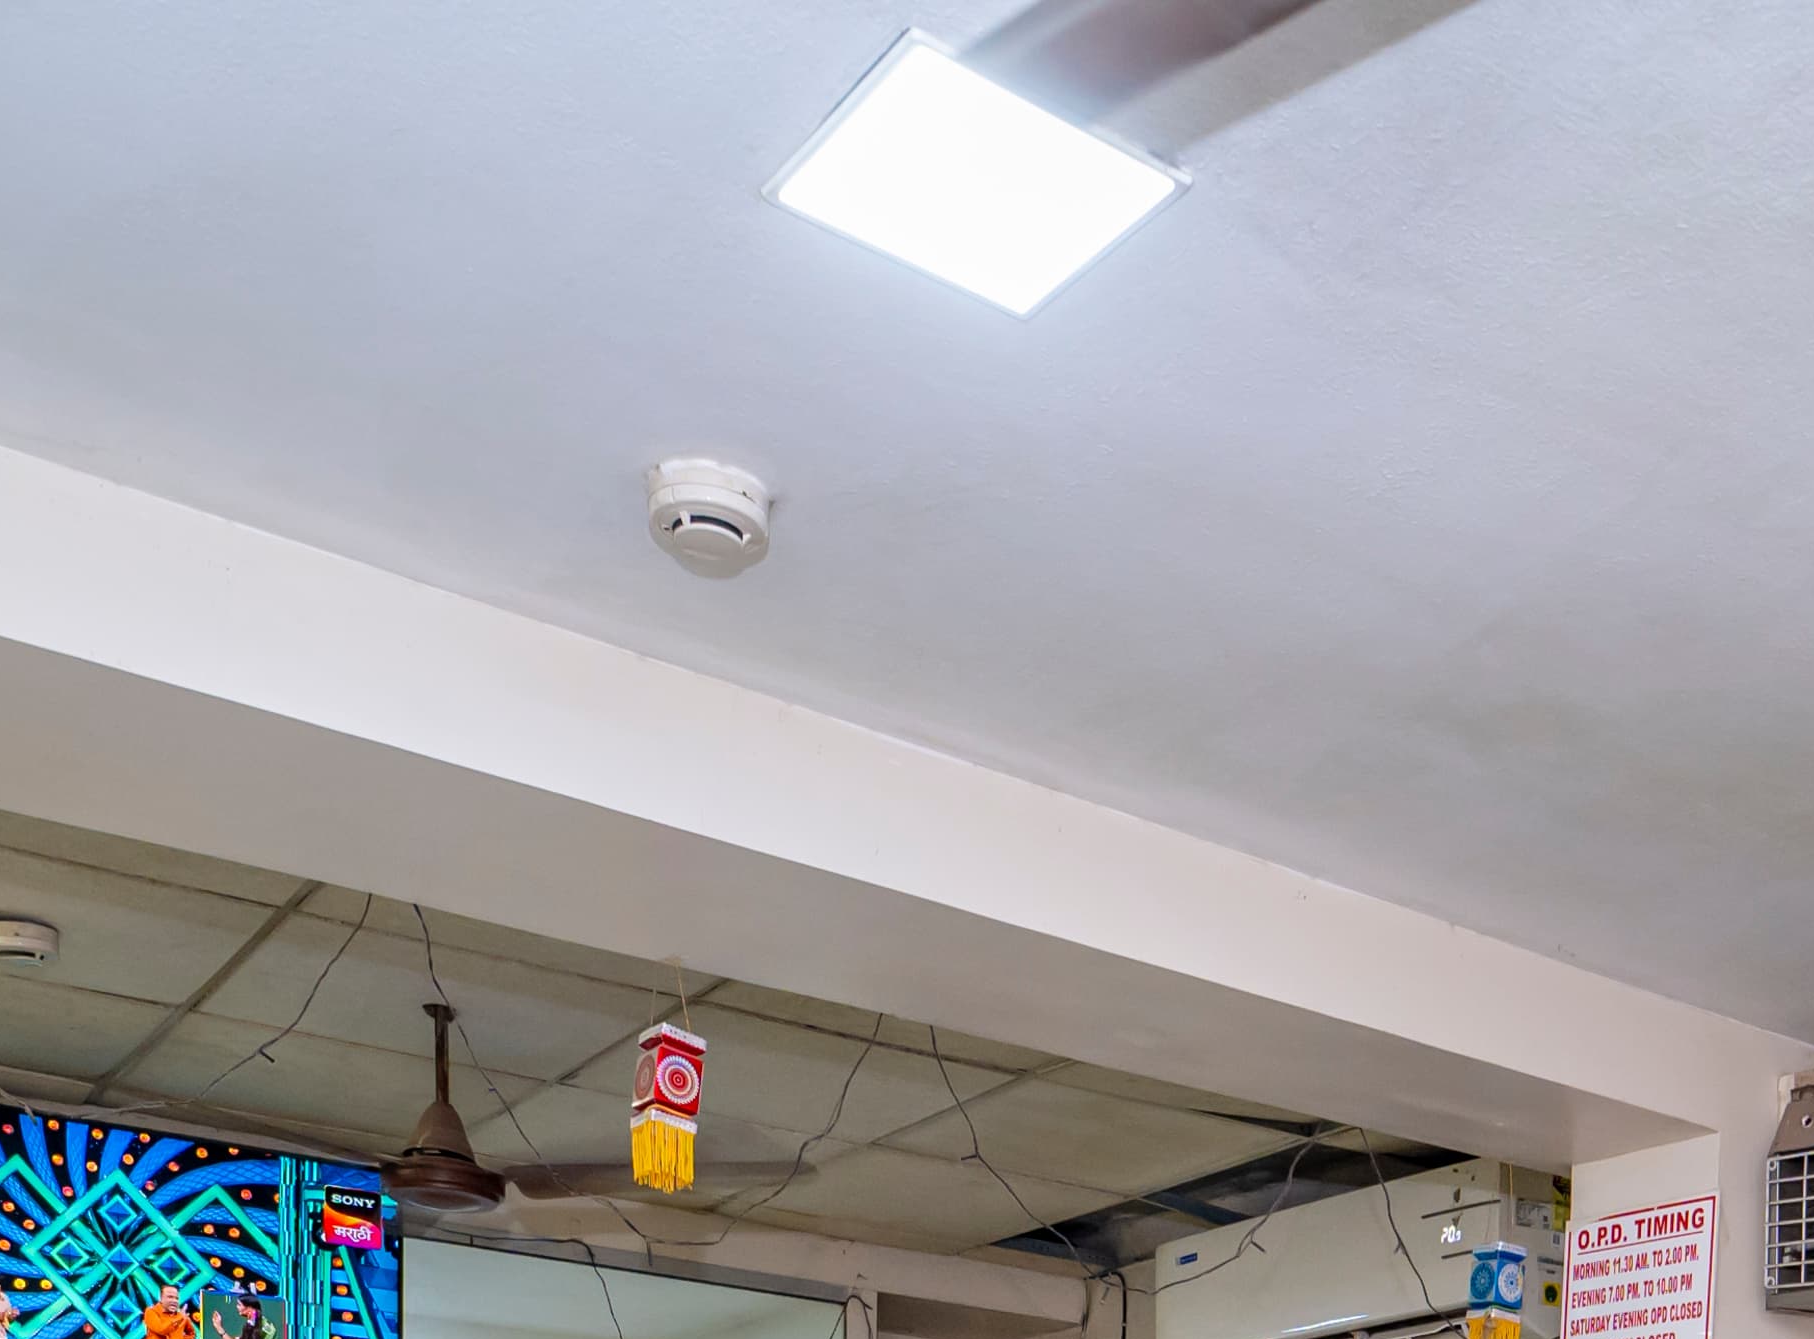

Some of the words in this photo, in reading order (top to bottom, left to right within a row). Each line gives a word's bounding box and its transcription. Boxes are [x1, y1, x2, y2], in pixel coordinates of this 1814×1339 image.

[331, 1193, 376, 1209] SONY
[332, 1225, 374, 1243] मराठी
[1577, 1222, 1627, 1250] O.P.D.
[1635, 1207, 1705, 1239] TIMING
[1572, 1259, 1610, 1281] MORNING
[1612, 1255, 1633, 1274] 11.30
[1635, 1252, 1650, 1270] AM.
[1652, 1250, 1662, 1268] TO
[1665, 1247, 1683, 1265] 2.00
[1685, 1243, 1699, 1262] PM.
[1571, 1287, 1606, 1309] EVENING
[1608, 1285, 1625, 1303] 7.00
[1627, 1282, 1640, 1300] PM.
[1643, 1280, 1654, 1298] TO
[1656, 1277, 1678, 1296] 10.00
[1680, 1273, 1693, 1291] PM
[1570, 1315, 1611, 1337] SATURDAY
[1613, 1310, 1648, 1330] EVENING
[1650, 1306, 1667, 1324] OPD
[1669, 1300, 1703, 1323] CLOSED
